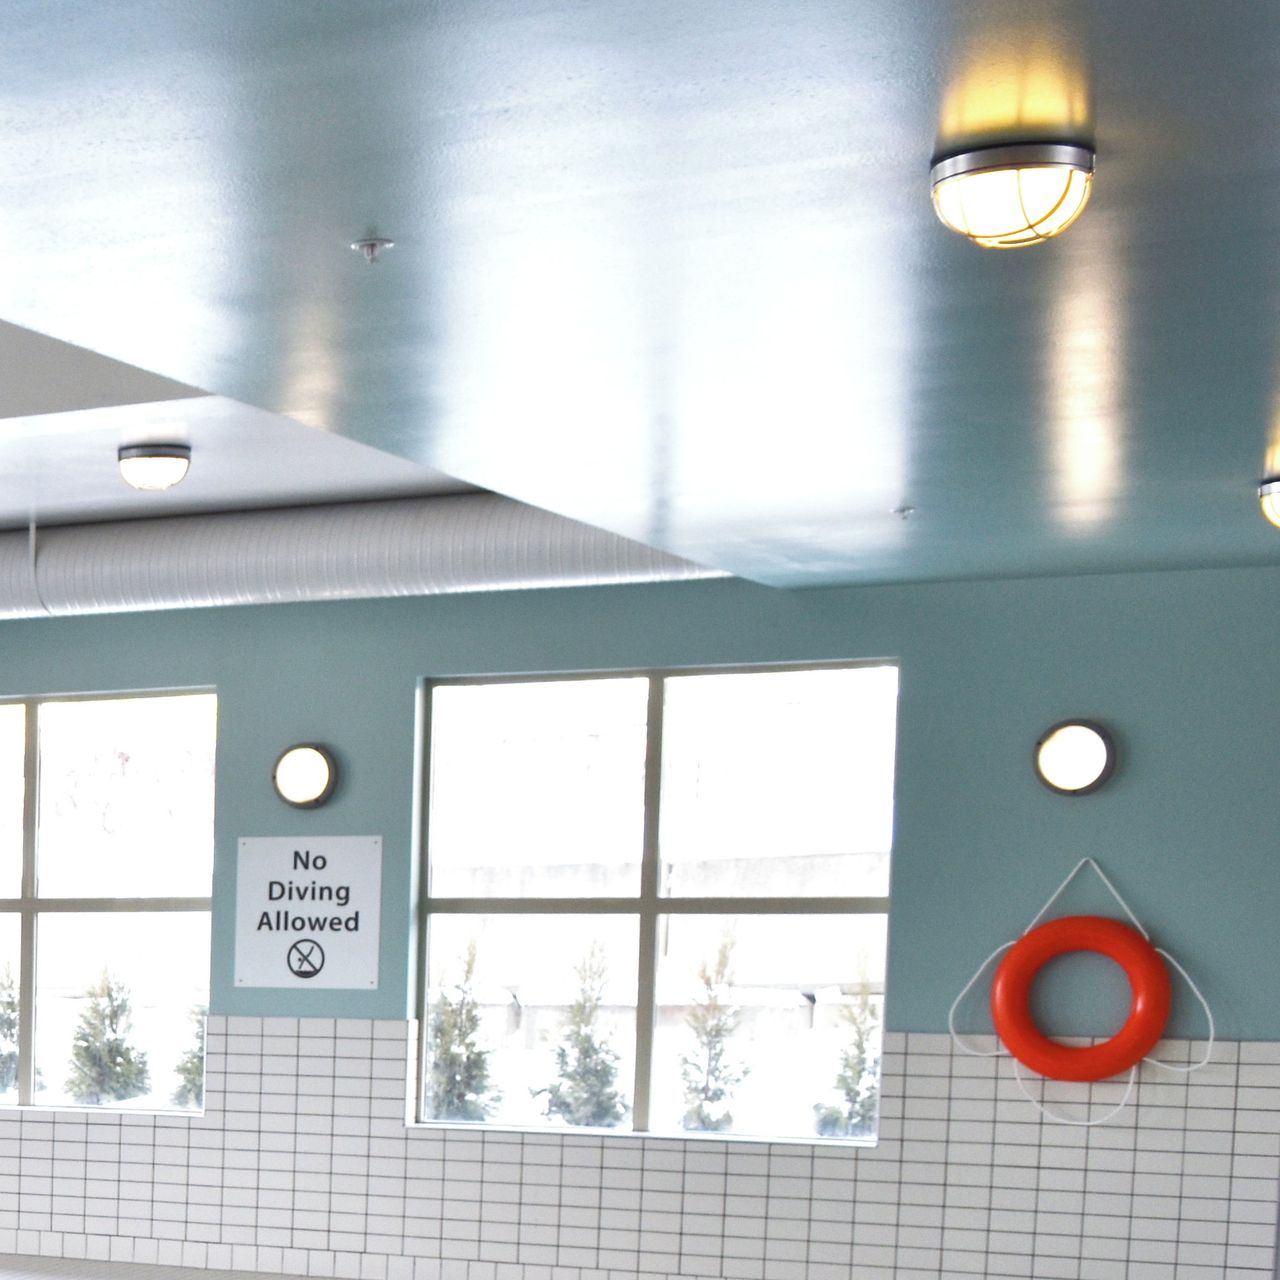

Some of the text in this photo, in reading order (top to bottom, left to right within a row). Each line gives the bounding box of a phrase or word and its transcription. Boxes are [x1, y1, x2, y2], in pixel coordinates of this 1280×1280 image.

[293, 850, 328, 871] No
[268, 880, 351, 907] Diving
[256, 910, 360, 932] Allowed
